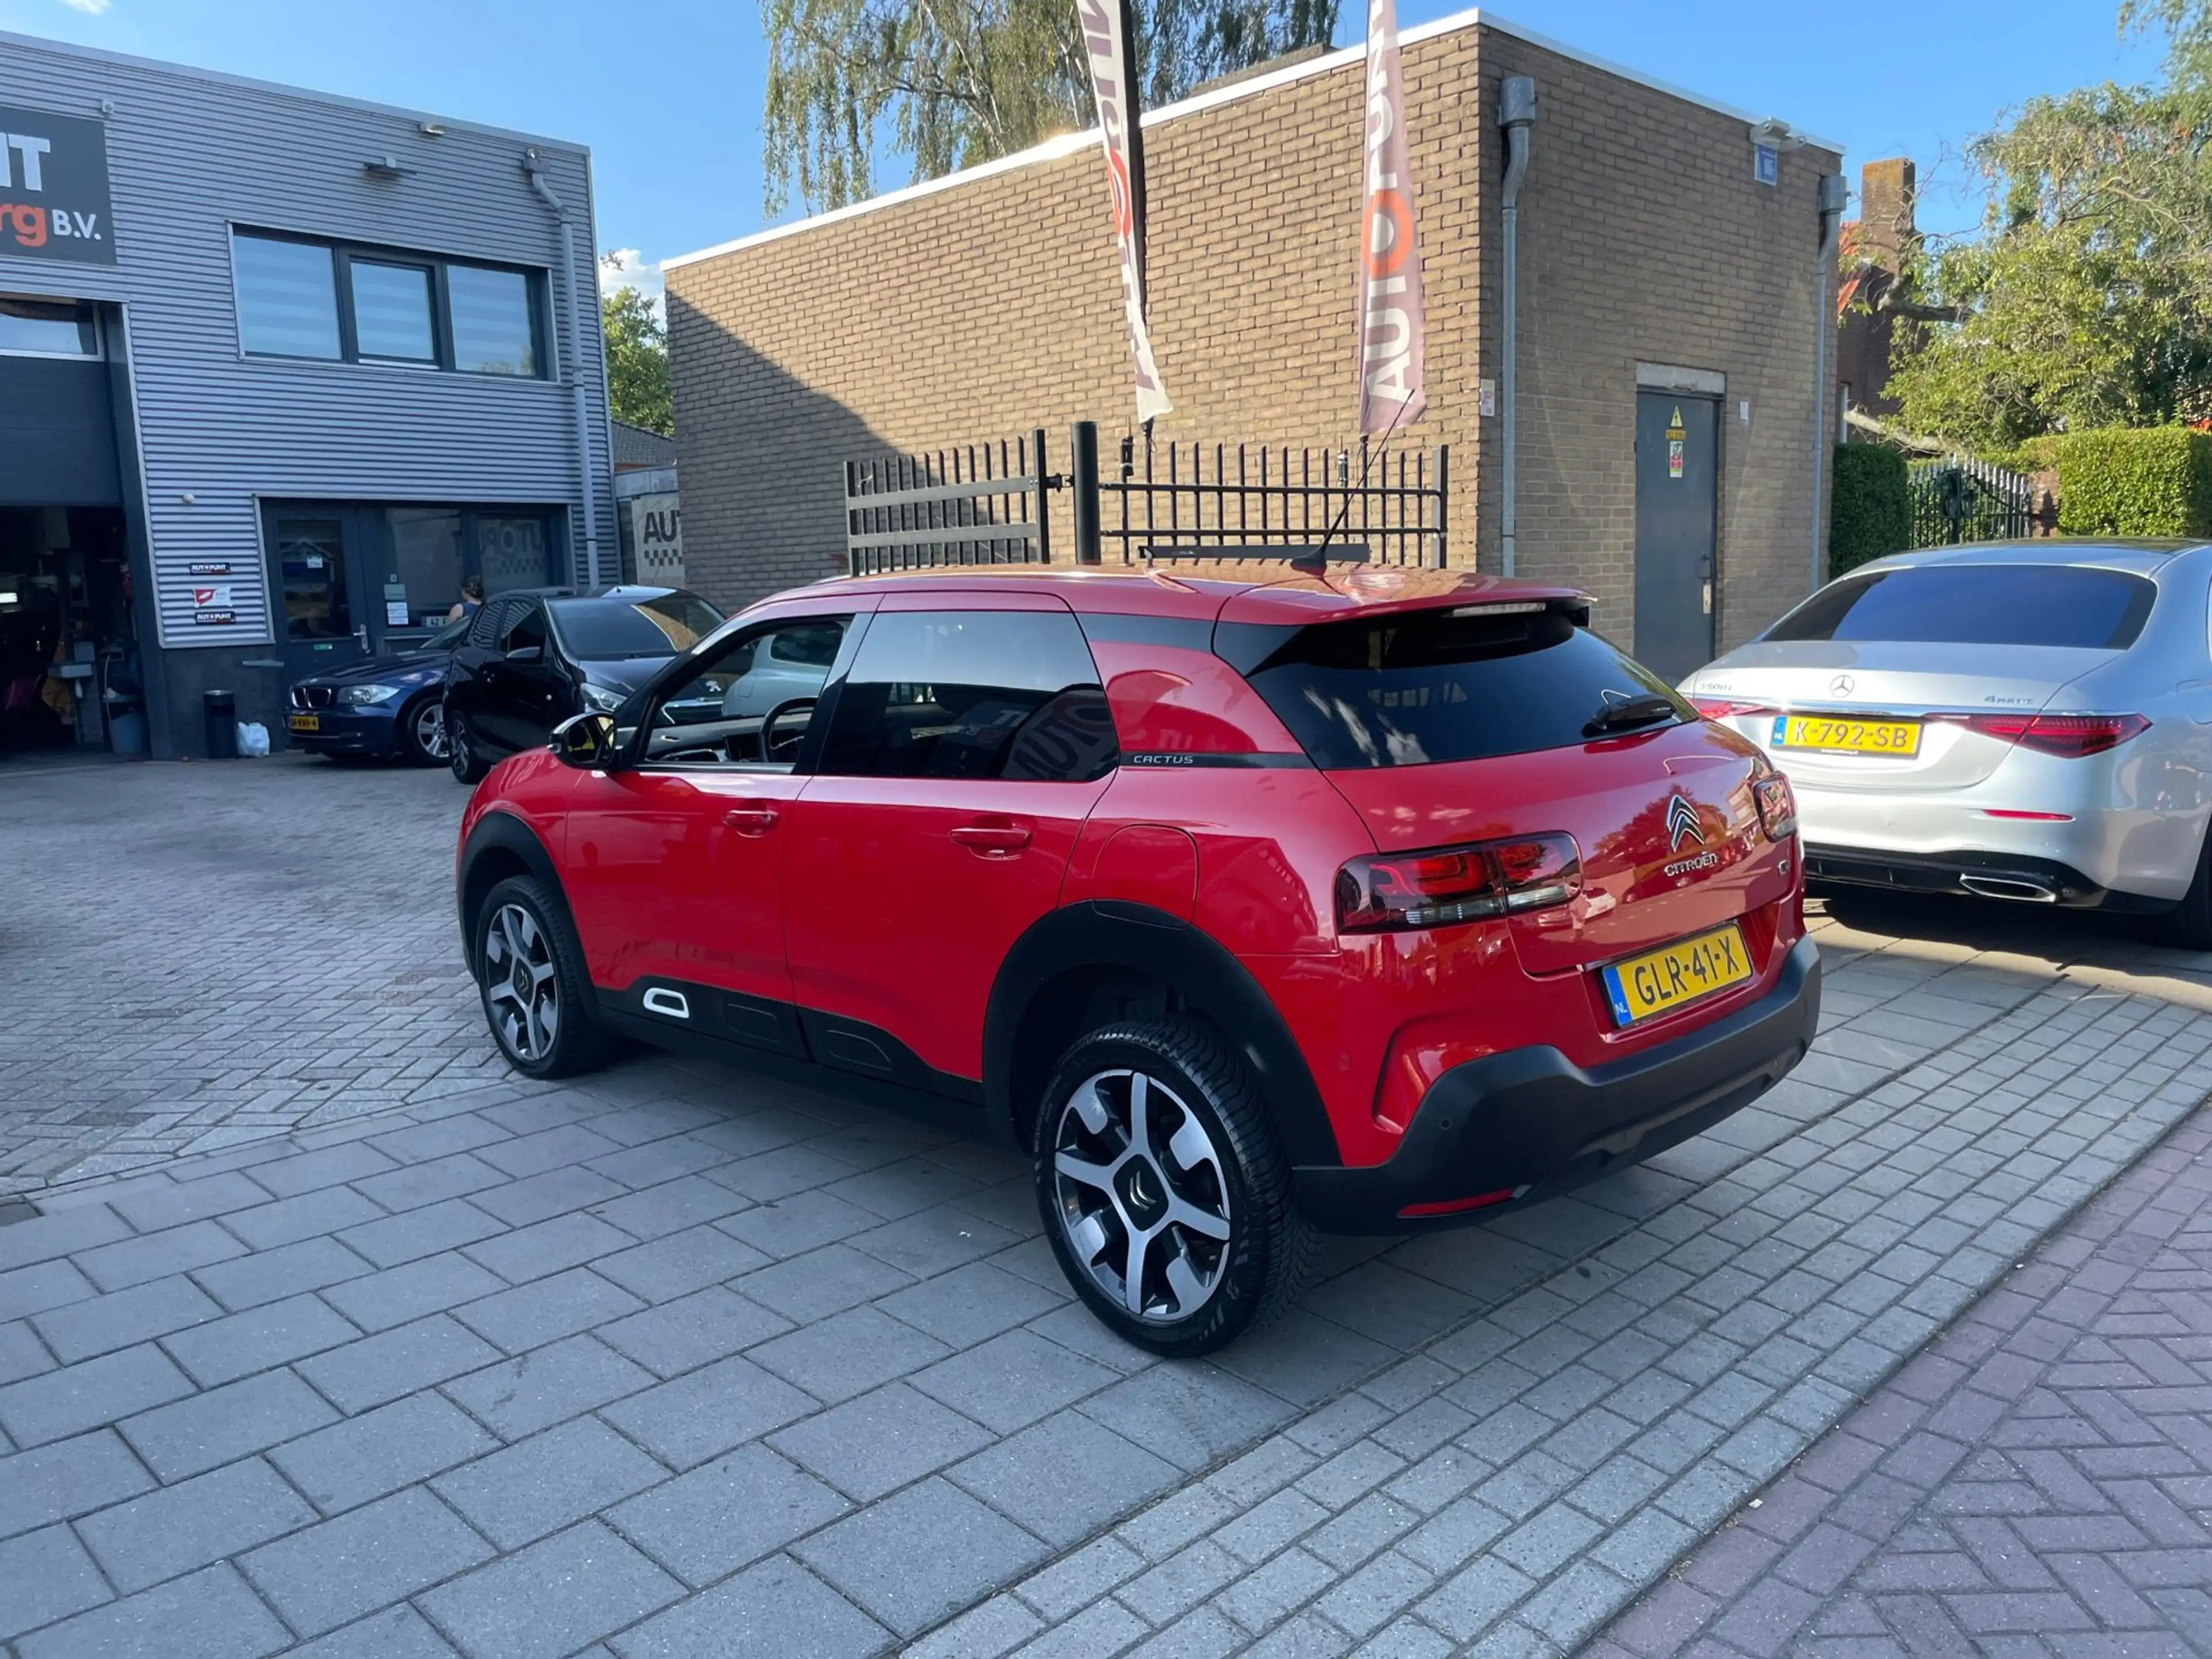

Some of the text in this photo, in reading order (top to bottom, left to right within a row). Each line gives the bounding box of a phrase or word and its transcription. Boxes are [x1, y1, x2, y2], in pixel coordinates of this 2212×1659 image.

[52, 209, 101, 241] B.V.
[643, 509, 680, 544] AU
[1795, 721, 1908, 748] K-792-SB
[1133, 755, 1194, 764] CACTUS
[1615, 935, 1740, 1015] NL GLR-41-X
